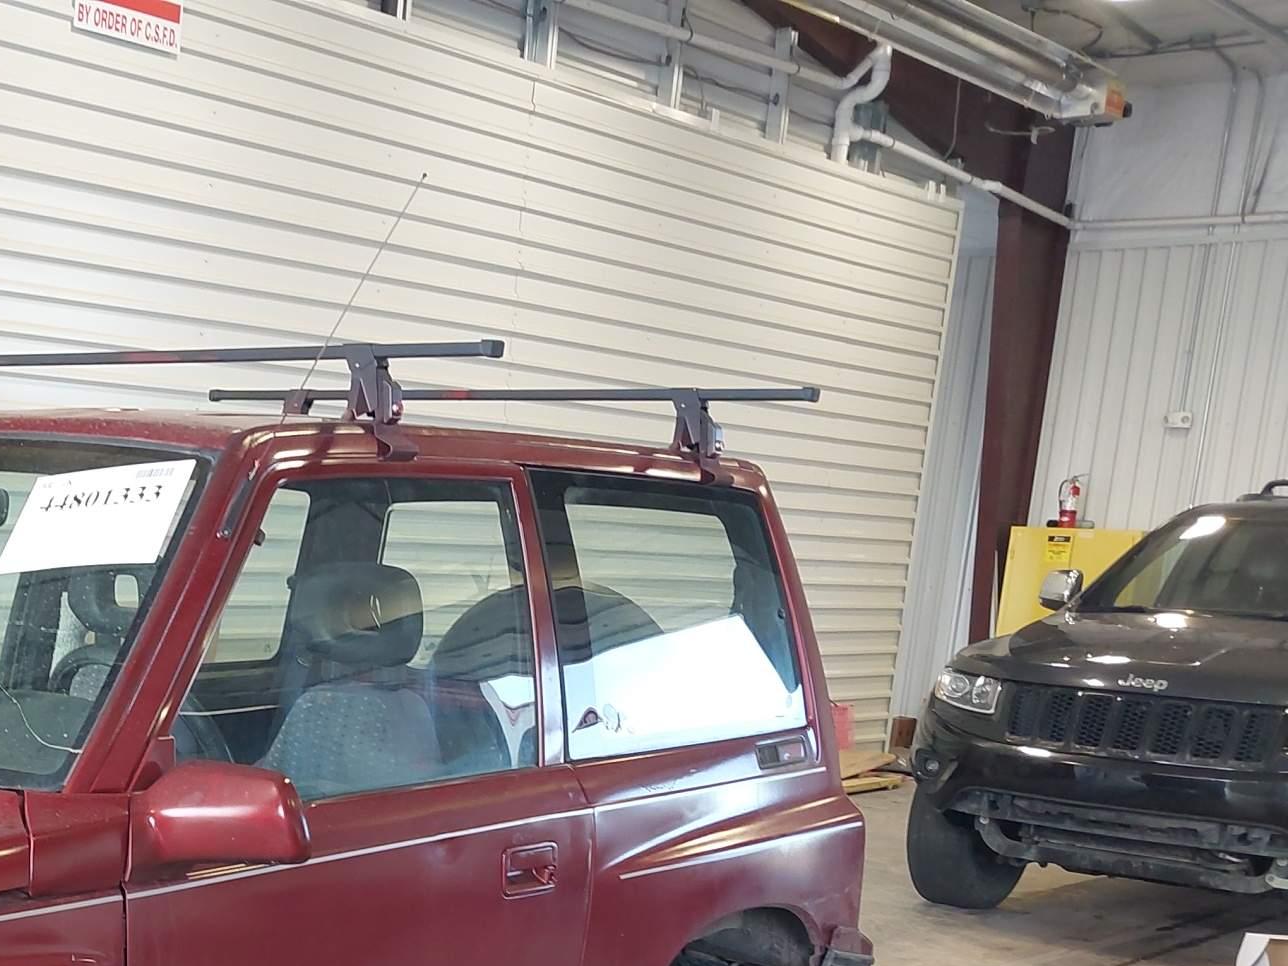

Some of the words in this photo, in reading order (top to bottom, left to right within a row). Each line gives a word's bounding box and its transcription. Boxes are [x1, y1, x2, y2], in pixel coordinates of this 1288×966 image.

[77, 3, 91, 24] BY
[93, 8, 127, 39] ORDER
[130, 17, 143, 40] OF
[144, 23, 178, 48] C.S.F.D.
[40, 484, 163, 512] 44801333
[1117, 673, 1168, 692] Jeep
